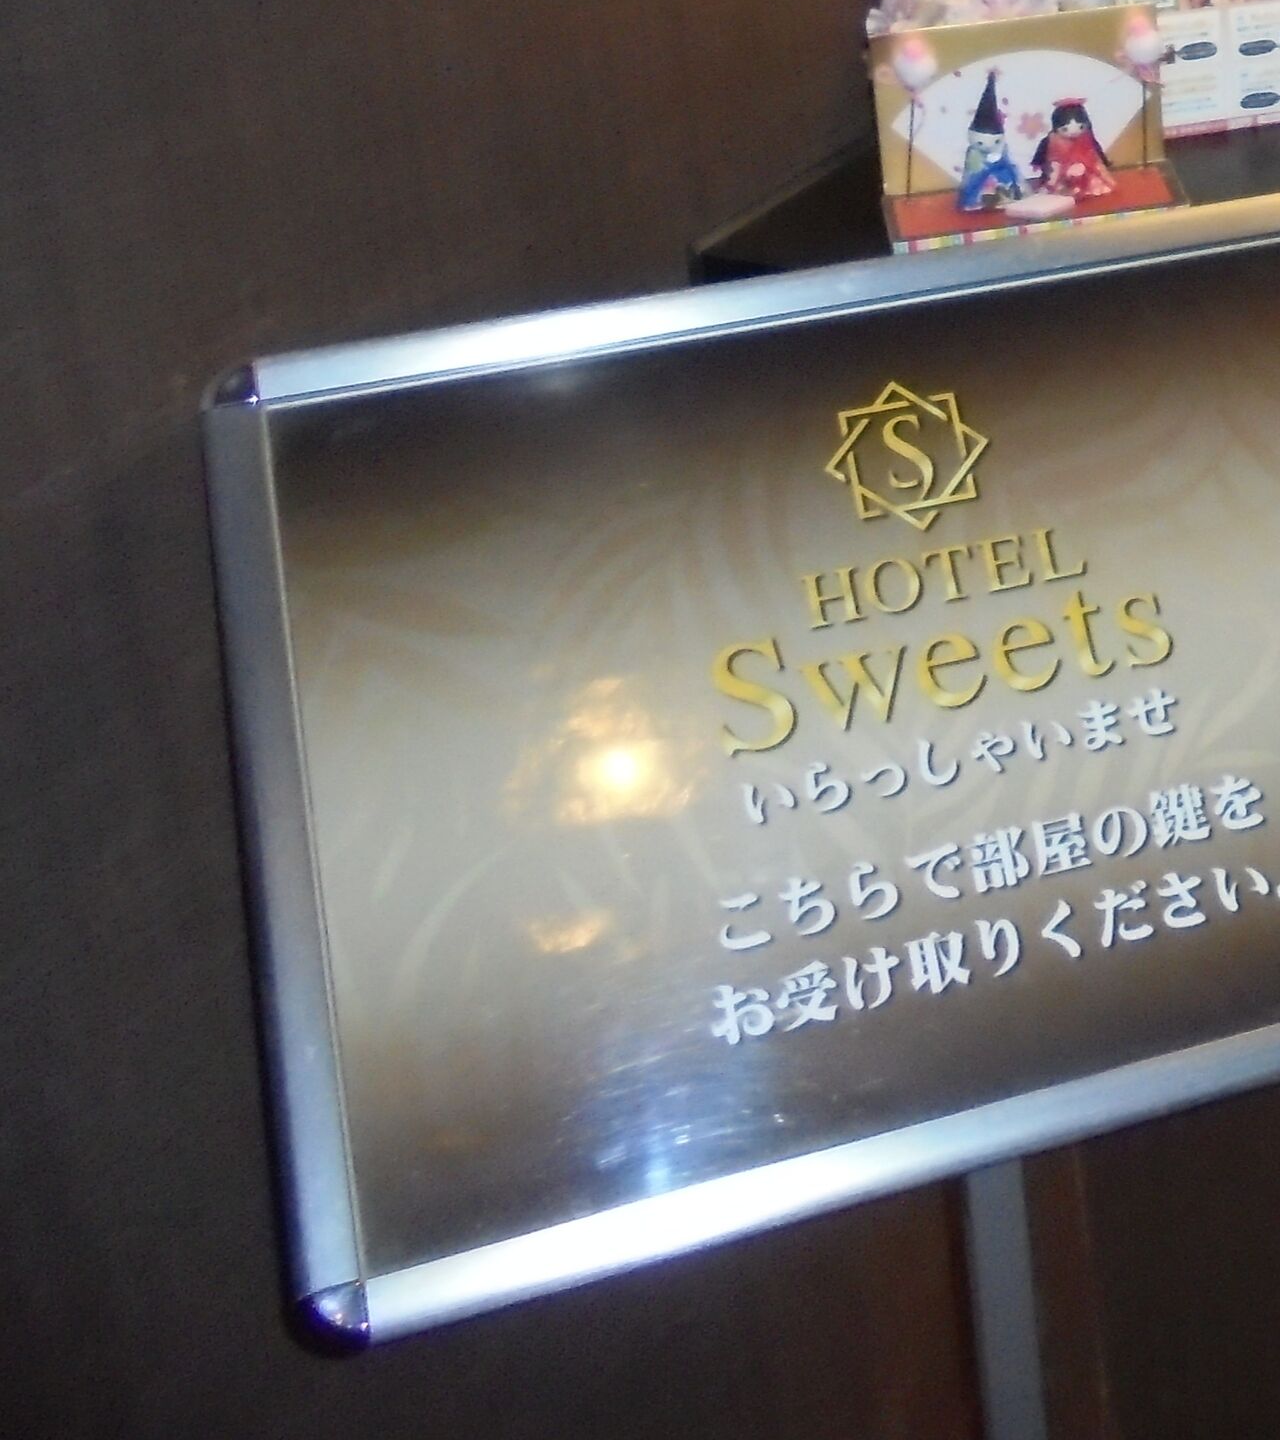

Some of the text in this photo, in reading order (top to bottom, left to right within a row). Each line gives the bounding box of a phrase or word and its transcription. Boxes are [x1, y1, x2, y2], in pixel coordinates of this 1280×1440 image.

[881, 412, 935, 502] S
[802, 527, 1088, 630] HOTEL
[712, 590, 1174, 757] Sweets
[741, 687, 1180, 827] いらっしゃいませ
[717, 773, 1265, 952] こちらで部屋の鍵を
